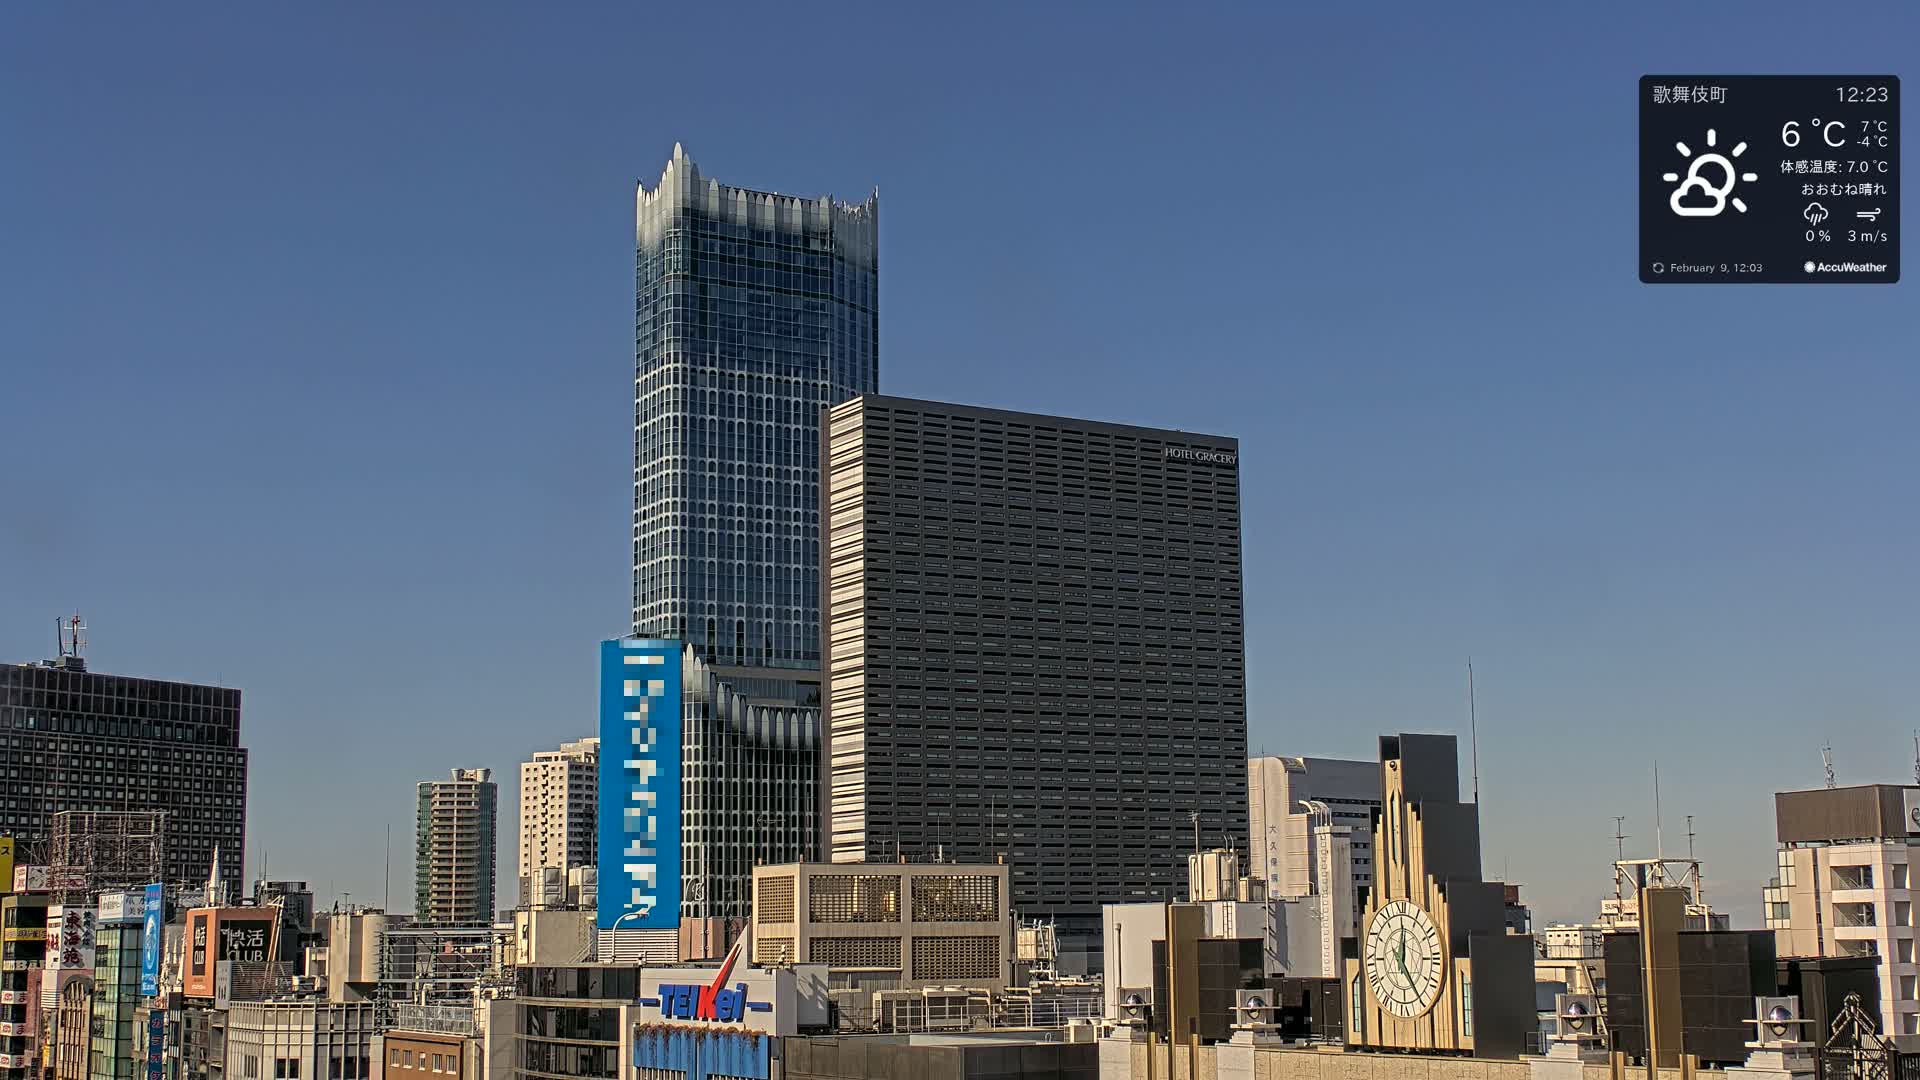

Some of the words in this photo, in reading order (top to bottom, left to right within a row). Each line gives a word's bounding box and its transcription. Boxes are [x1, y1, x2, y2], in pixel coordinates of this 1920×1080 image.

[1165, 447, 1195, 460] HOTEL
[1195, 450, 1237, 465] GRACERY
[62, 910, 82, 964] 東海苑
[229, 929, 264, 947] 快活
[229, 949, 264, 963] CLUB
